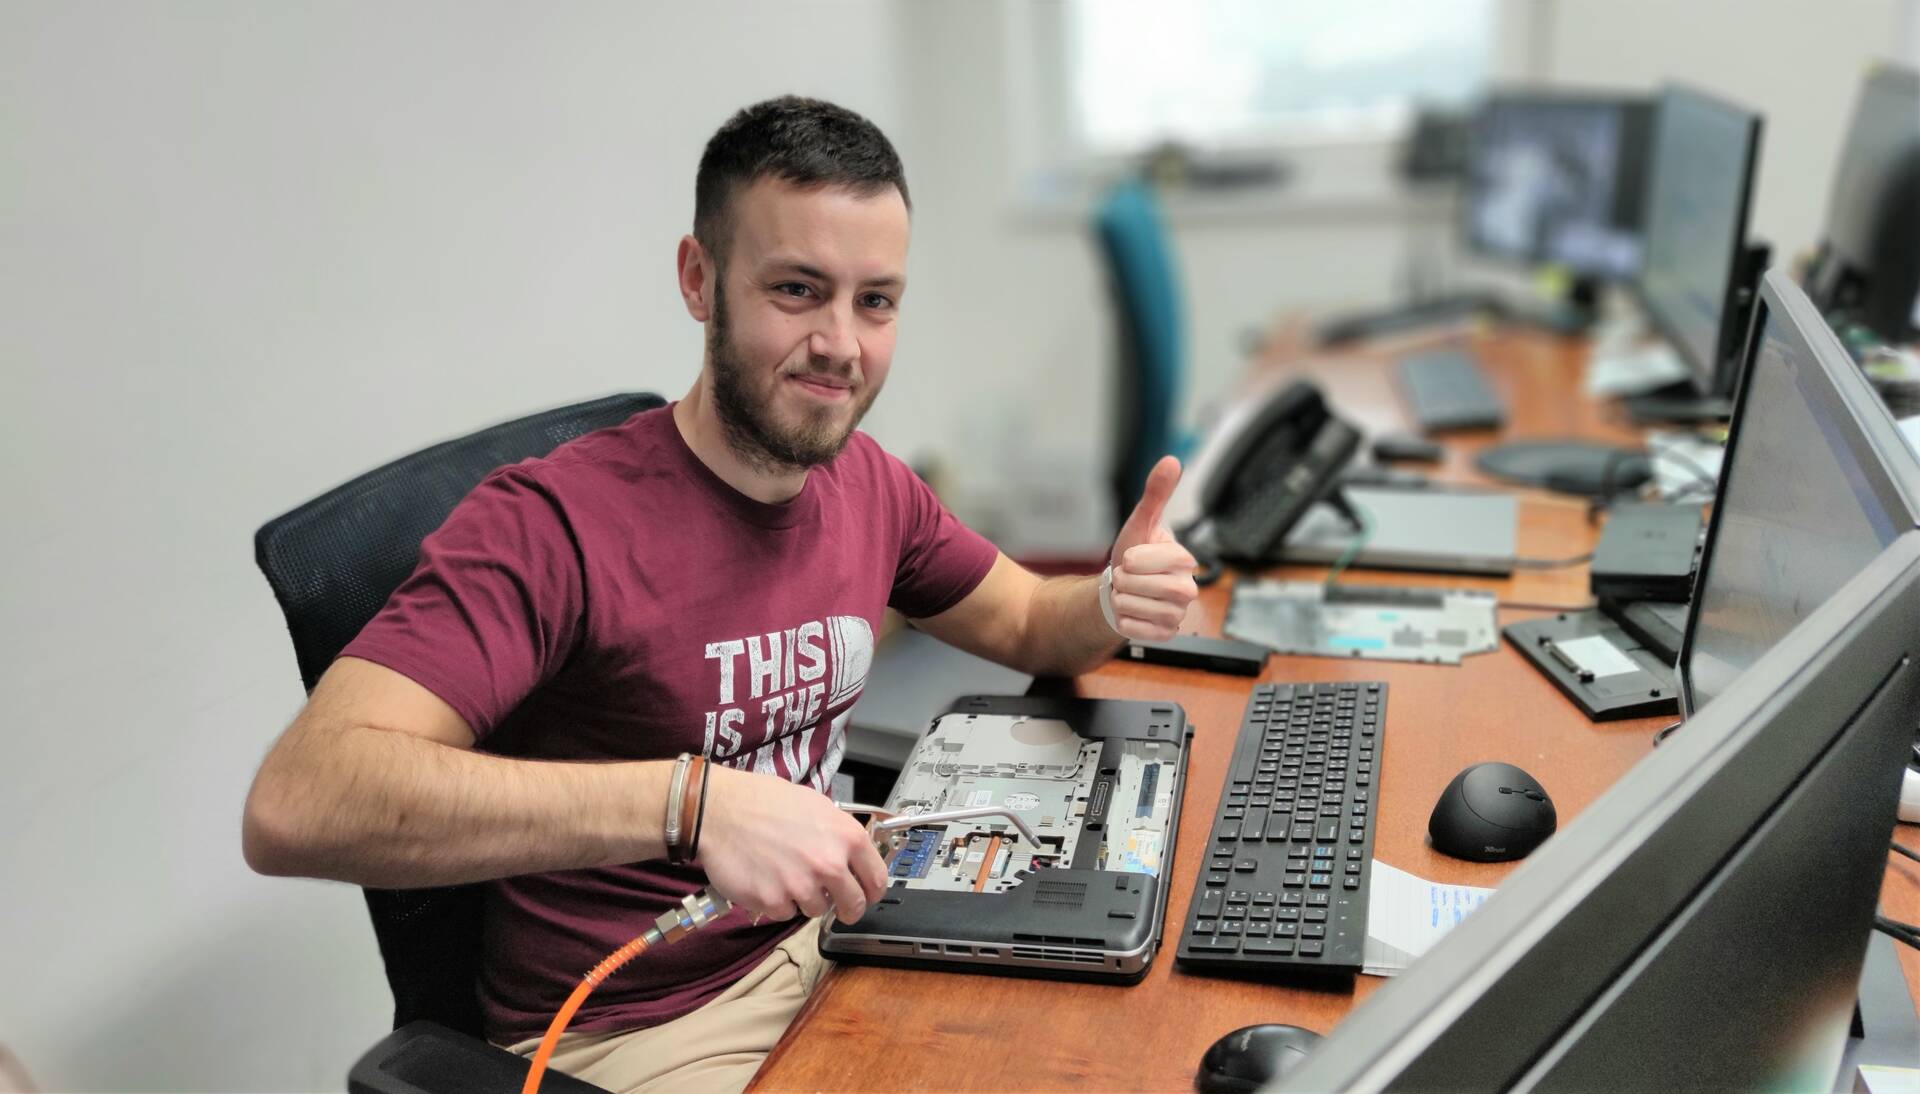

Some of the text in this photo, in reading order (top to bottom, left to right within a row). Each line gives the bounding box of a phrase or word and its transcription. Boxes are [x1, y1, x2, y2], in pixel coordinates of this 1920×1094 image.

[704, 620, 826, 705] THIS
[702, 708, 745, 760] IS
[762, 682, 826, 743] THE
